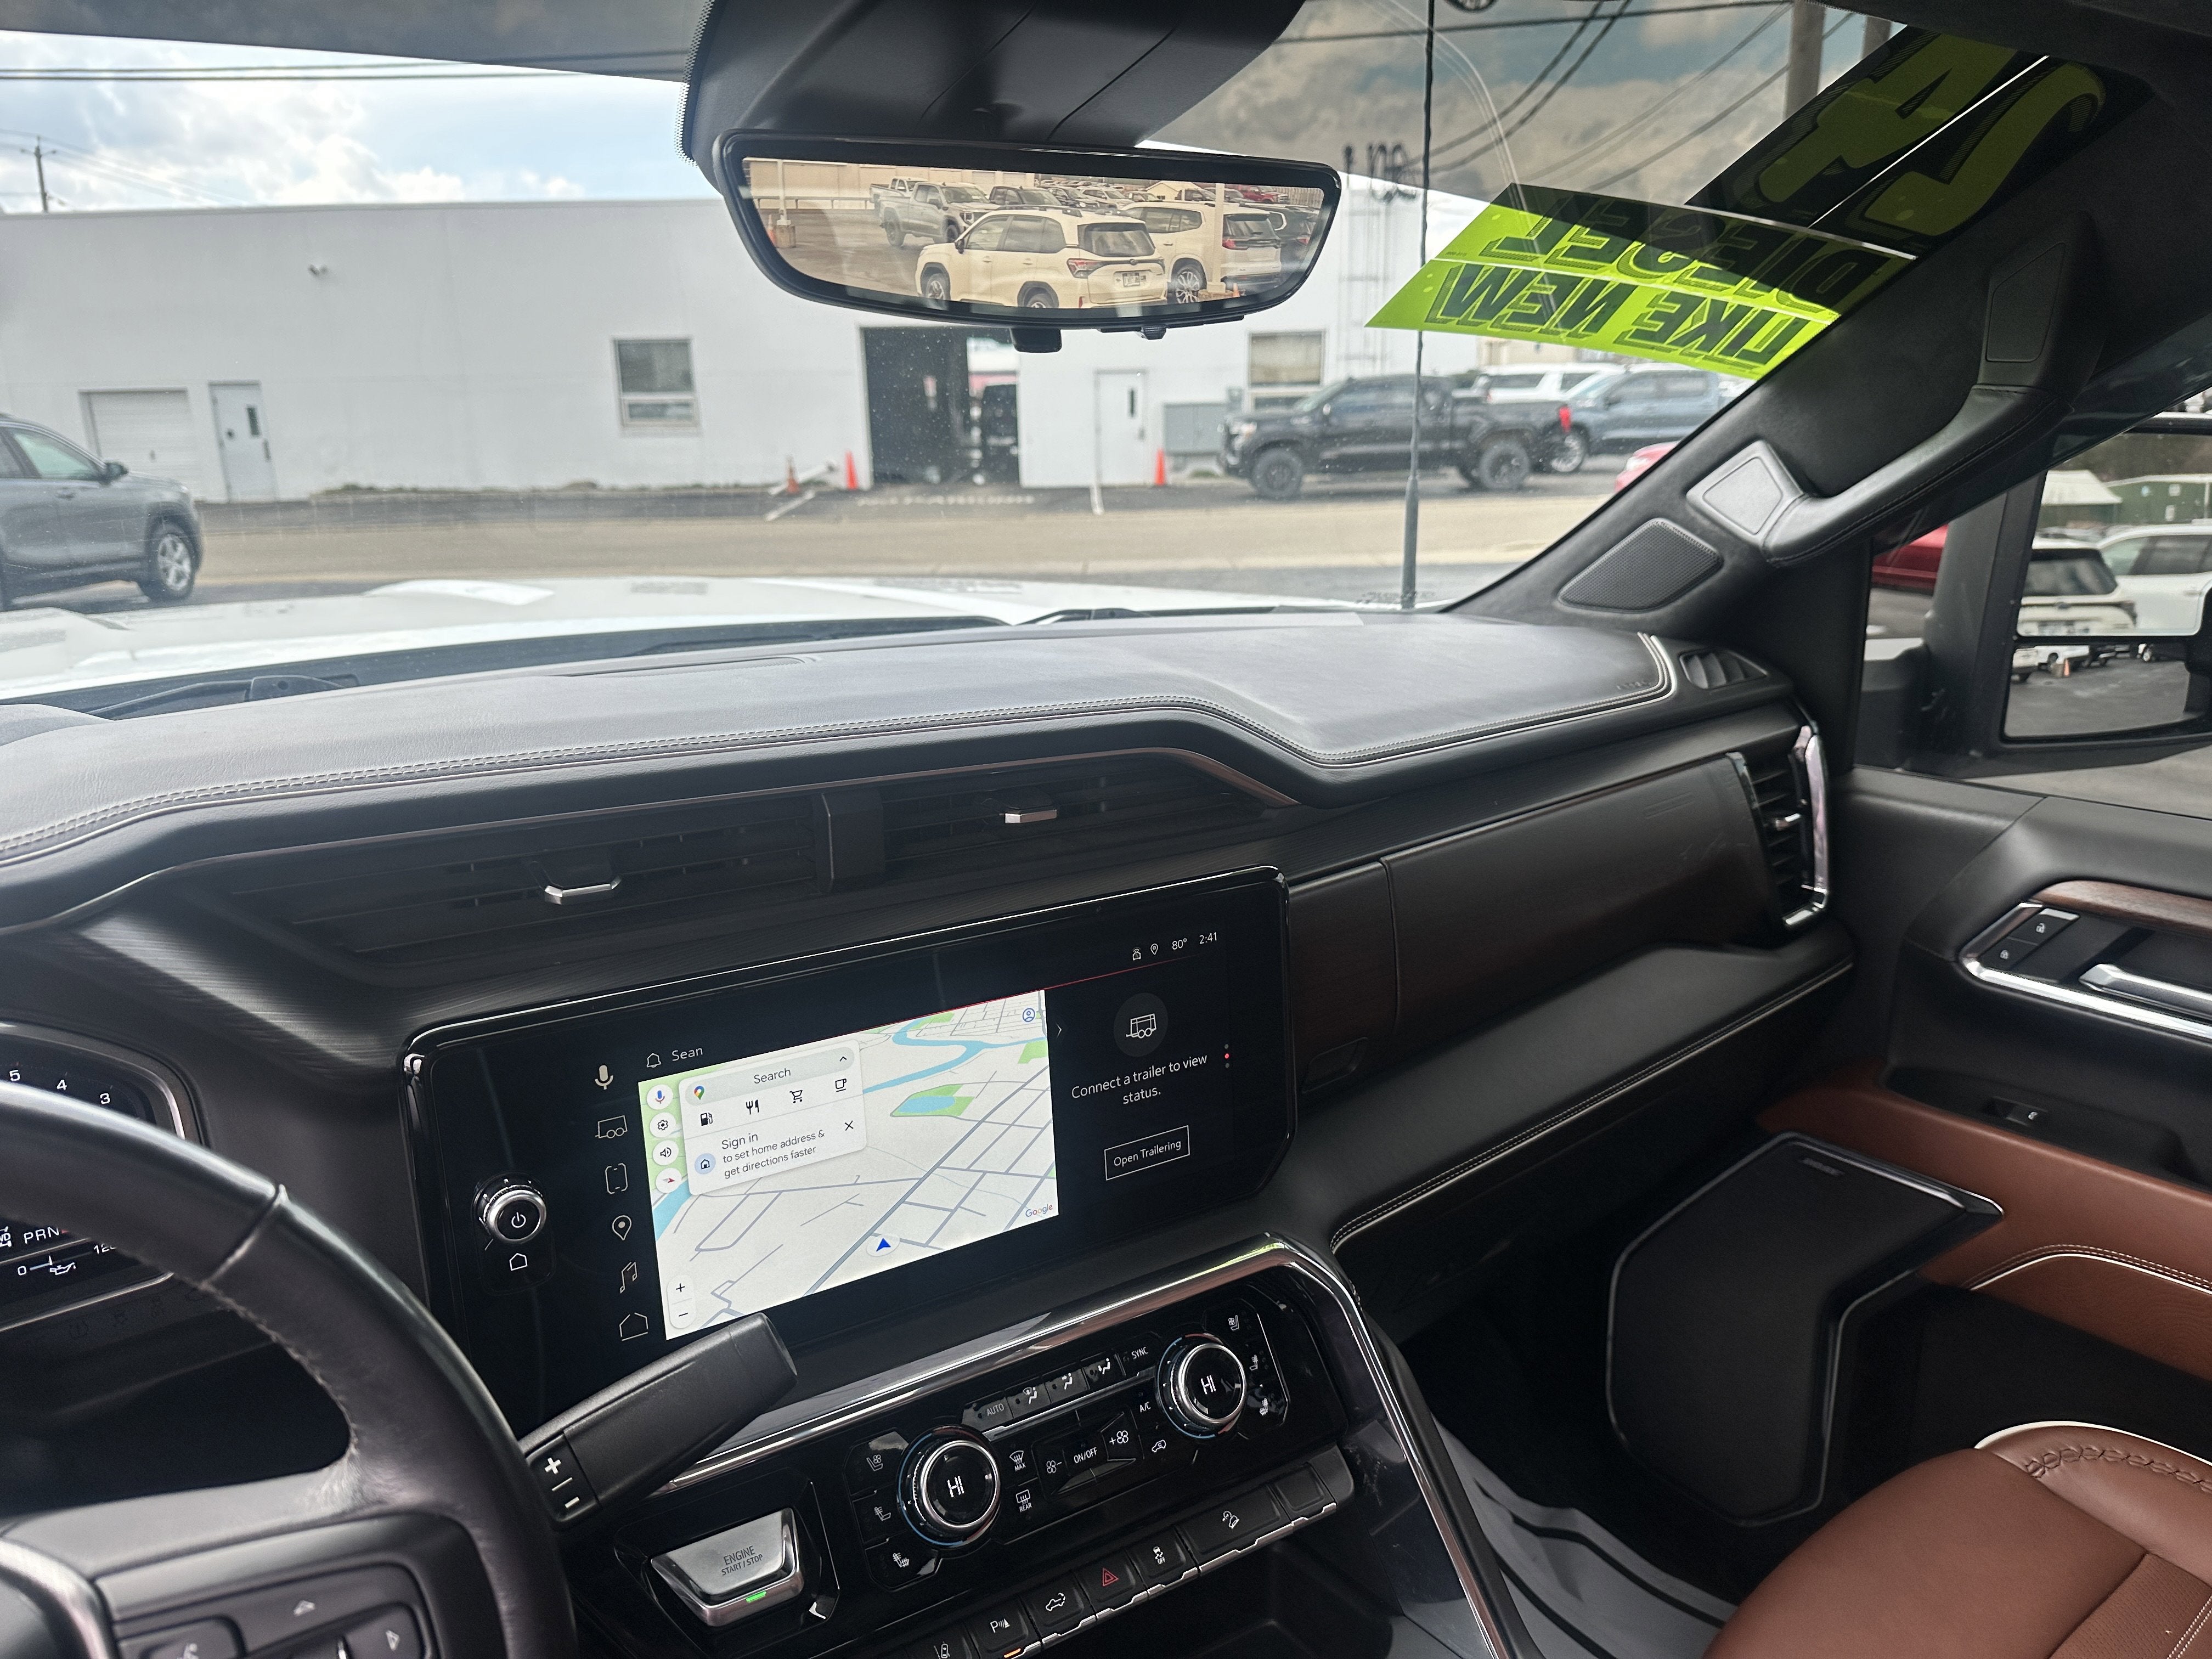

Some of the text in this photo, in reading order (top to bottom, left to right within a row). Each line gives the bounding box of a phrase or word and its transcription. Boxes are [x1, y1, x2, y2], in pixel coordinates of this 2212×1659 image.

[1199, 932, 1218, 945] 2:41
[672, 1047, 703, 1062] Sean
[9, 1069, 21, 1082] 5
[753, 1068, 792, 1085] Search
[1071, 1055, 1208, 1098] Connect a trailer to view
[56, 1079, 67, 1091] 4
[99, 1092, 111, 1105] 3
[1122, 1085, 1161, 1104] status.
[721, 1132, 759, 1151] Sign in
[723, 1130, 825, 1163] to set home address &
[1113, 1139, 1182, 1167] Open Trailering
[724, 1146, 817, 1180] get directions faster
[1025, 1204, 1053, 1217] Google
[17, 1266, 27, 1276] 0
[1131, 1346, 1149, 1360] SYNC
[1200, 1375, 1216, 1395] HI
[987, 1403, 1005, 1417] AUTO
[1139, 1401, 1151, 1413] A/C
[1074, 1447, 1098, 1464] ON/OFF
[1014, 1463, 1026, 1471] MAX
[947, 1476, 965, 1498] HI
[1019, 1502, 1032, 1513] REAR
[724, 1546, 755, 1565] ENGINE
[1158, 1556, 1166, 1565] OFF
[721, 1562, 741, 1576] START
[747, 1554, 763, 1566] STOP
